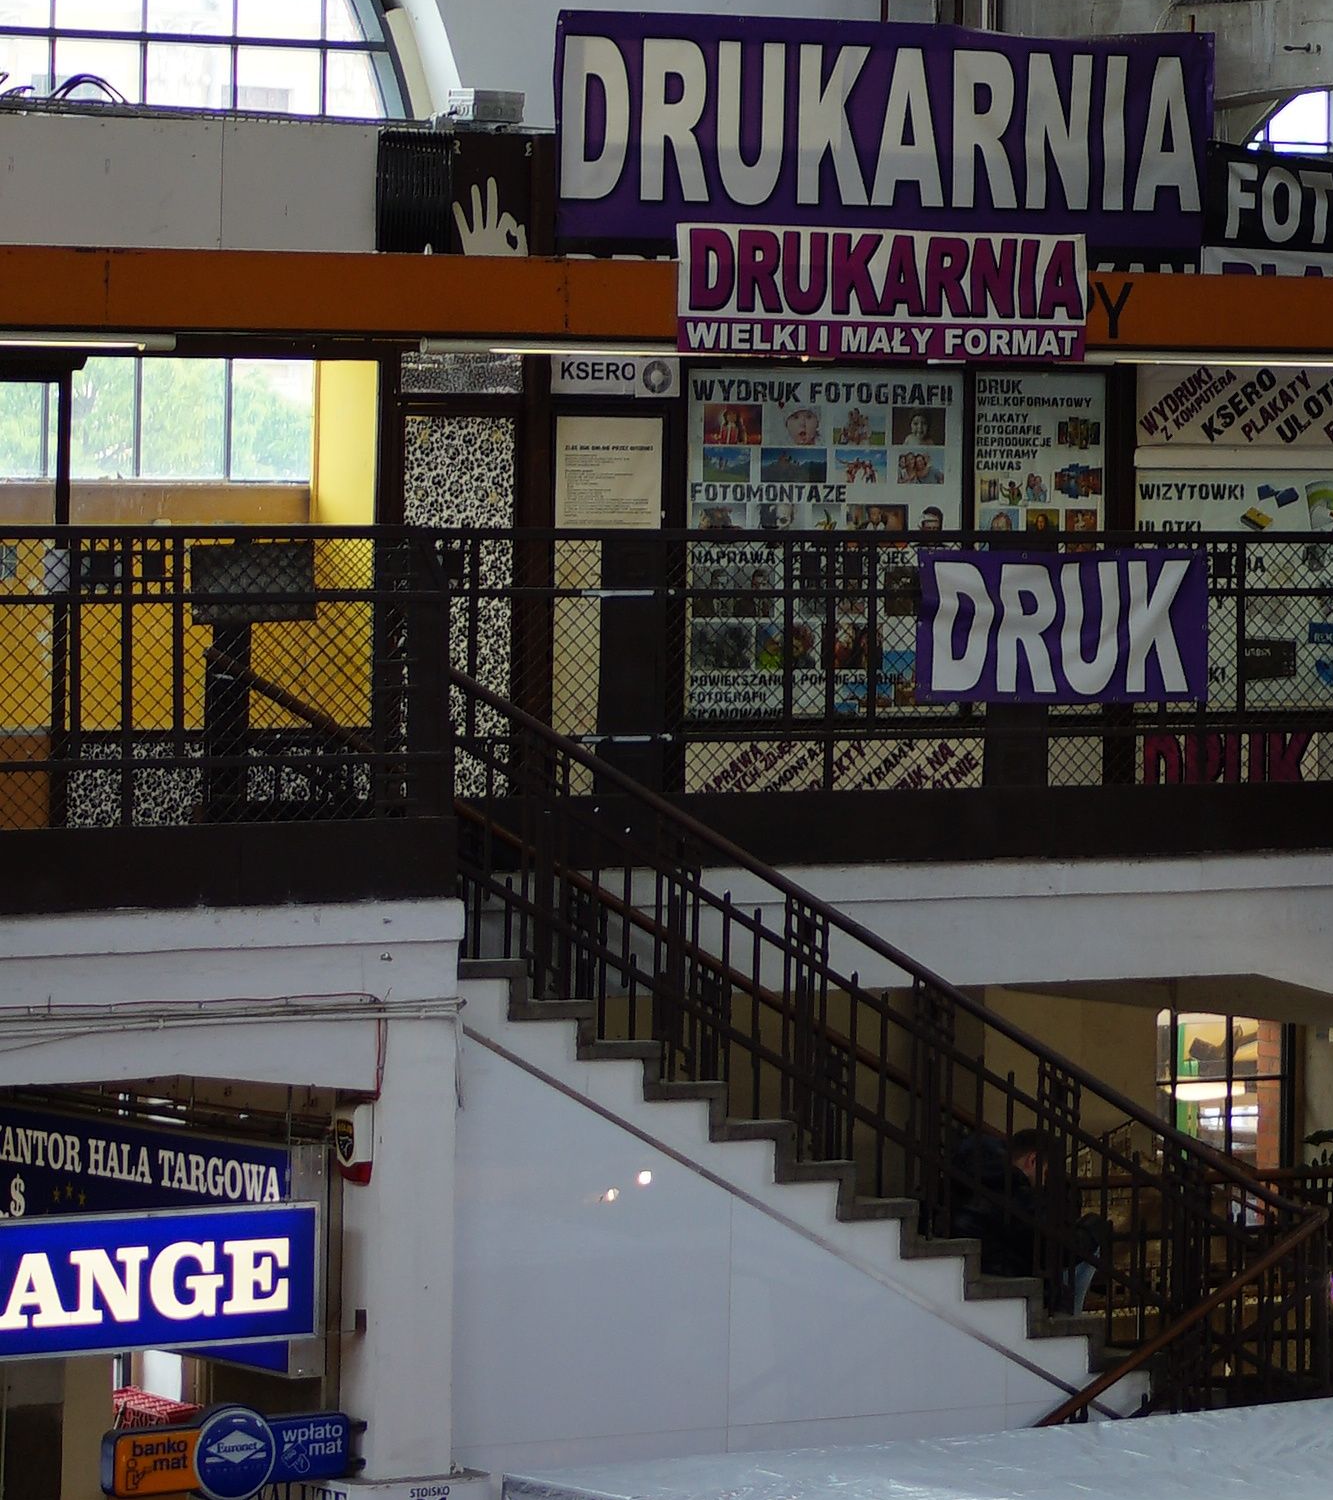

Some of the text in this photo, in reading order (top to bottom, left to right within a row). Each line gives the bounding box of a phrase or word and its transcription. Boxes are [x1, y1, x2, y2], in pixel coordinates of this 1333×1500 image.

[559, 33, 1202, 213] DRUKARNIA
[689, 228, 1084, 318] DRUKARNIA
[687, 322, 1078, 357] WIELKI I MAŁY FORMAT
[560, 361, 636, 381] KSERO
[692, 379, 953, 406] WYDRUK FOTOGRAFII
[977, 379, 1022, 395] DRUK
[1139, 365, 1214, 436] WYDRUKI
[1174, 368, 1237, 430] KOMPUTERA
[977, 397, 1092, 408] WIELKOFORMATOWY
[1200, 367, 1277, 442] KSERO
[1240, 369, 1312, 442] PLAKATY
[976, 424, 1041, 436] FOTOGRAFIE
[977, 412, 1029, 423] PLAKATY
[976, 436, 1052, 448] REPRODUKCJE
[976, 449, 1038, 460] ANTYRAMY
[976, 460, 1022, 471] CANVAS
[931, 558, 1192, 697] DRUK
[87, 1138, 152, 1185] HALA
[158, 1149, 281, 1202] TARGOWA
[132, 1423, 344, 1457] banko wpłato
[216, 1440, 259, 1454] Euronet
[153, 1453, 188, 1471] mat
[308, 1439, 344, 1458] mat
[409, 1486, 451, 1498] STOISKO
